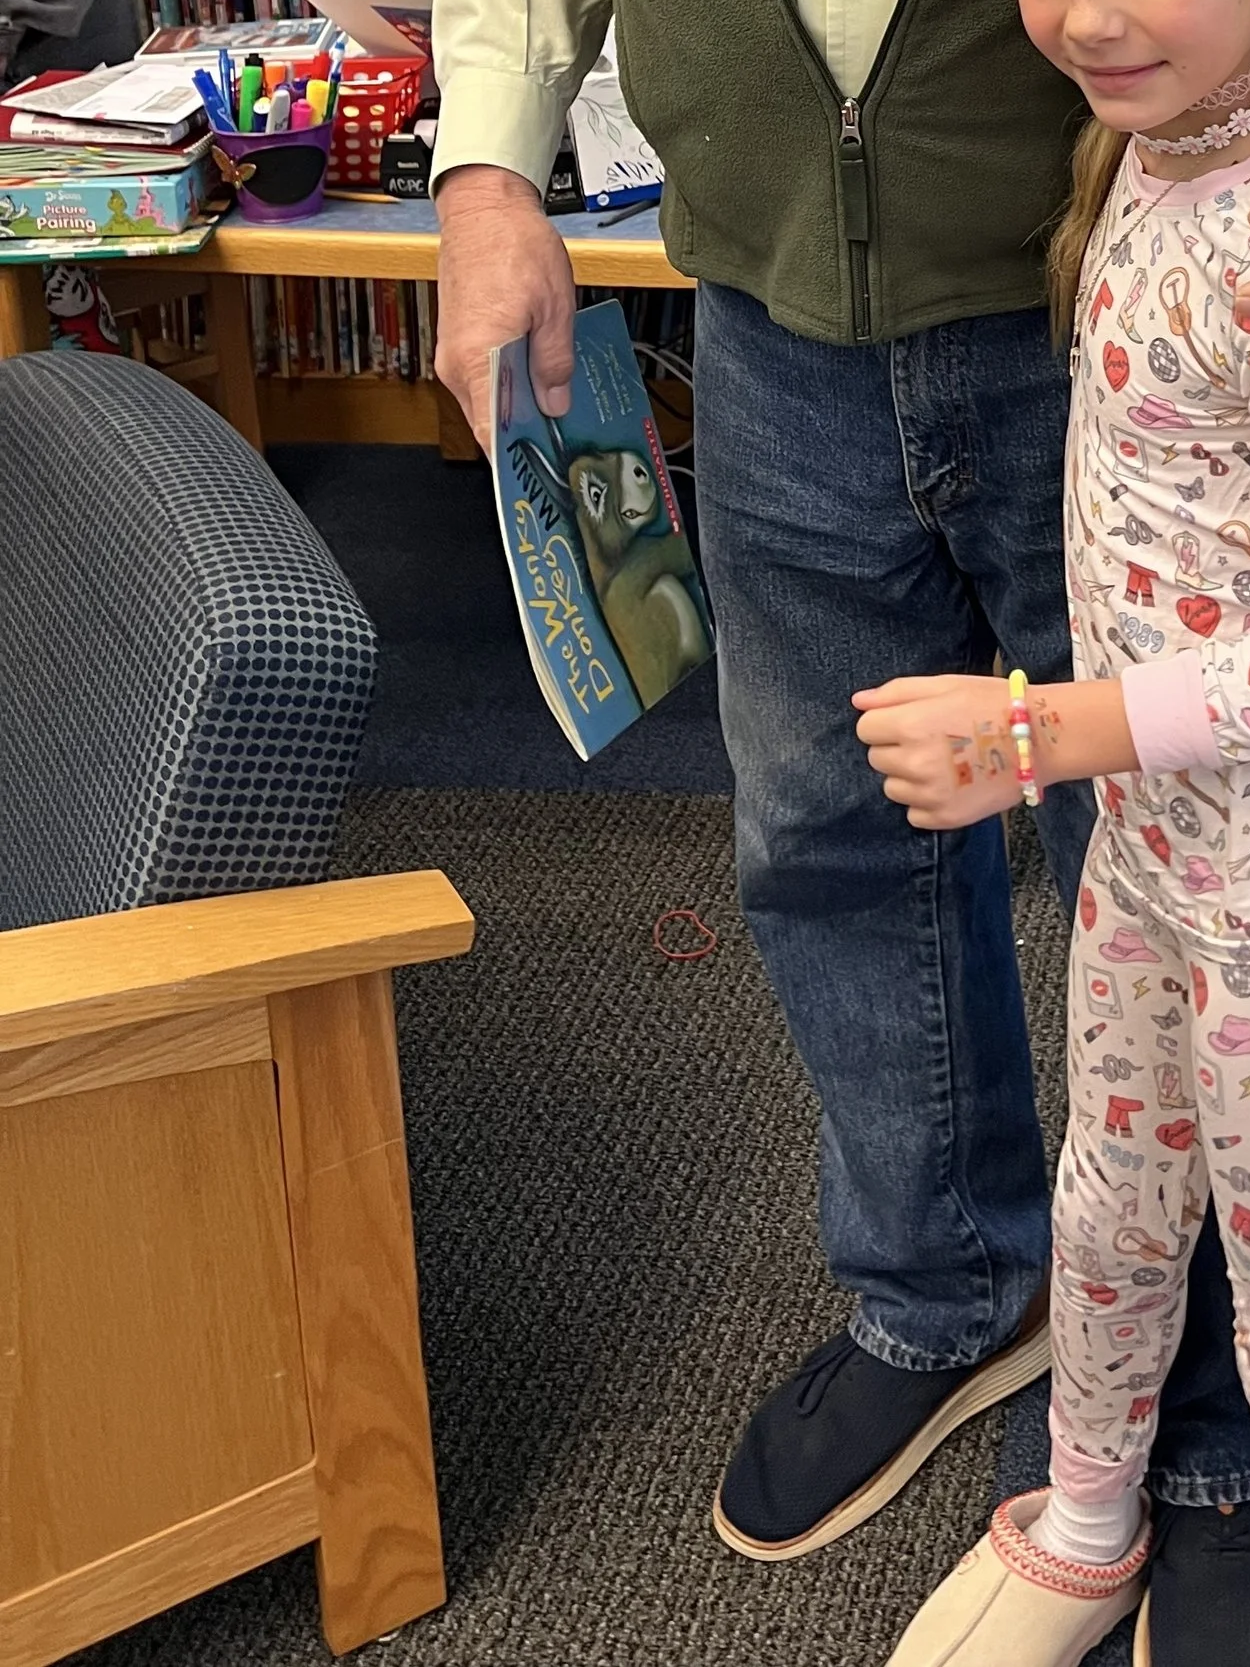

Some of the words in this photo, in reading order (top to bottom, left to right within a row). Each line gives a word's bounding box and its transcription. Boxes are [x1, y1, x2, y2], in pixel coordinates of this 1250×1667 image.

[389, 177, 424, 193] ACPC
[36, 217, 97, 233] Pairing
[43, 204, 87, 215] Picture
[514, 499, 567, 648] Wonky
[550, 534, 615, 703] Donkey
[1118, 612, 1166, 653] 1989
[561, 639, 590, 715] The
[1101, 1140, 1145, 1171] 1989
